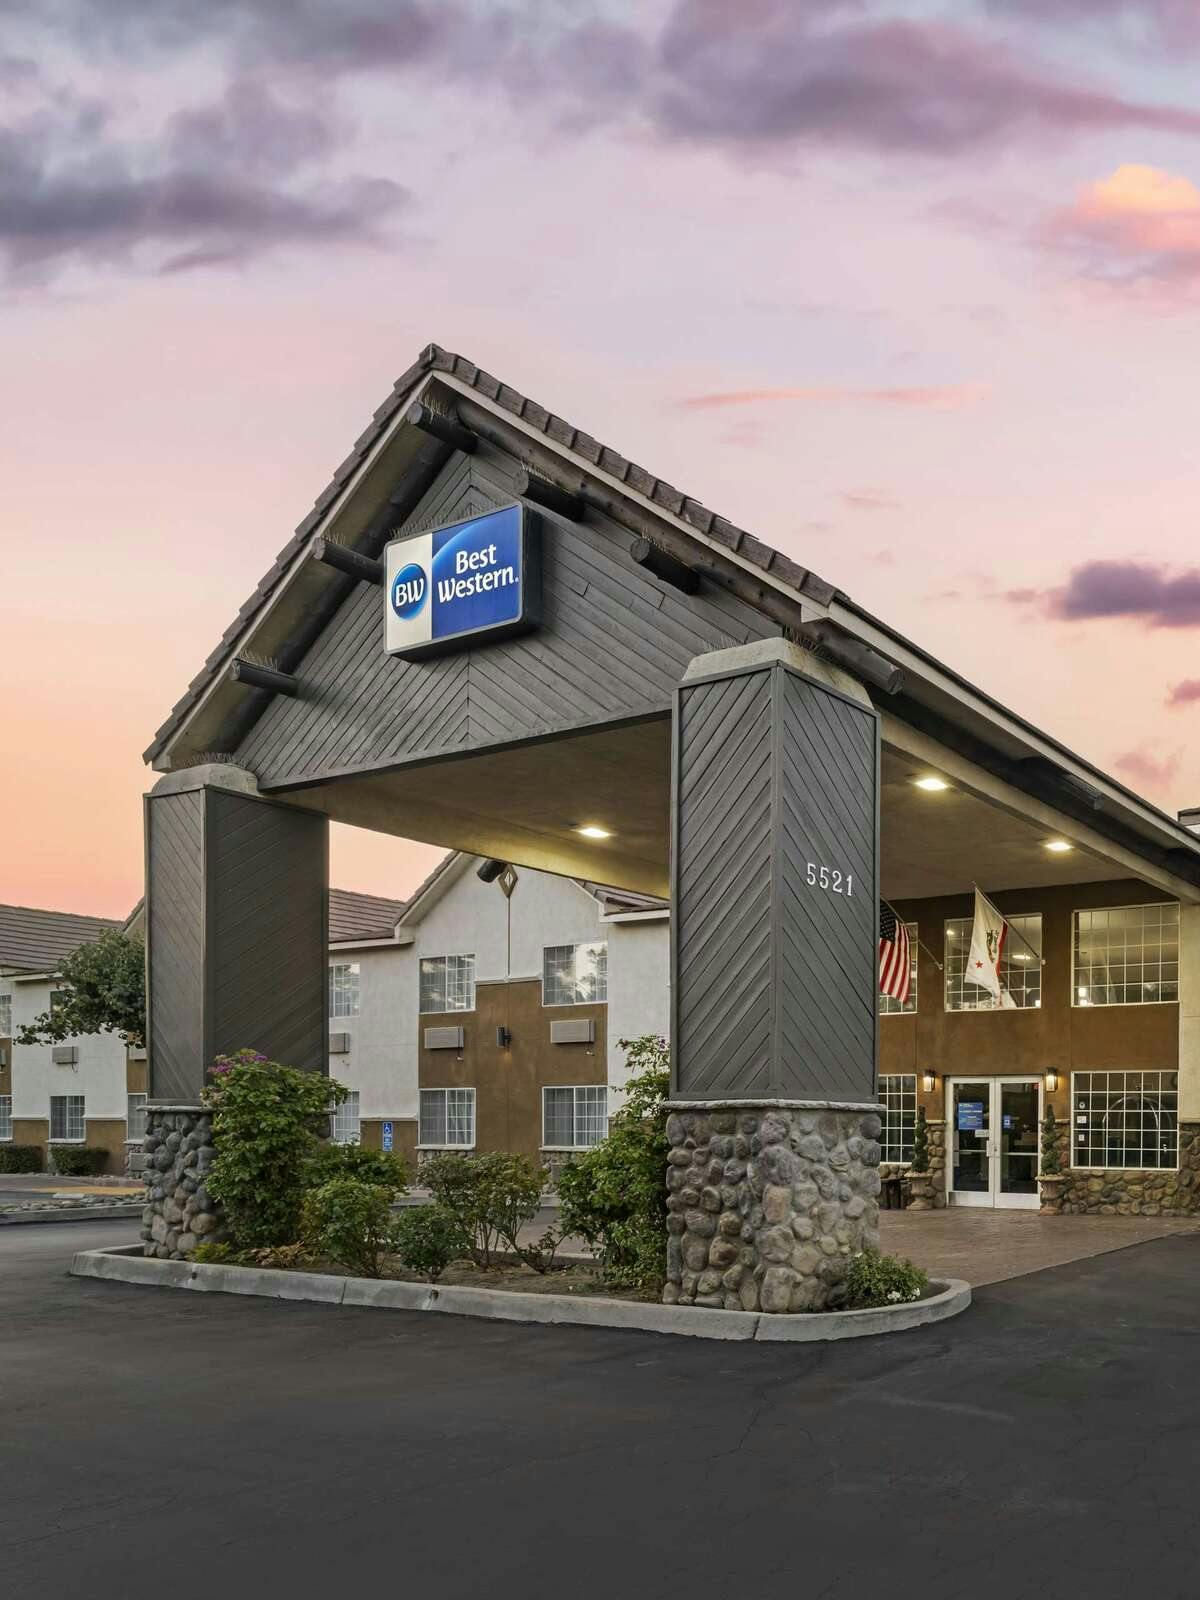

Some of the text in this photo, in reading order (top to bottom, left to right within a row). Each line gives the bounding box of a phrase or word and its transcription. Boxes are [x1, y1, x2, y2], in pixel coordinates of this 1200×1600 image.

[455, 543, 497, 574] Best
[395, 578, 424, 607] BW
[806, 862, 852, 896] 5521
